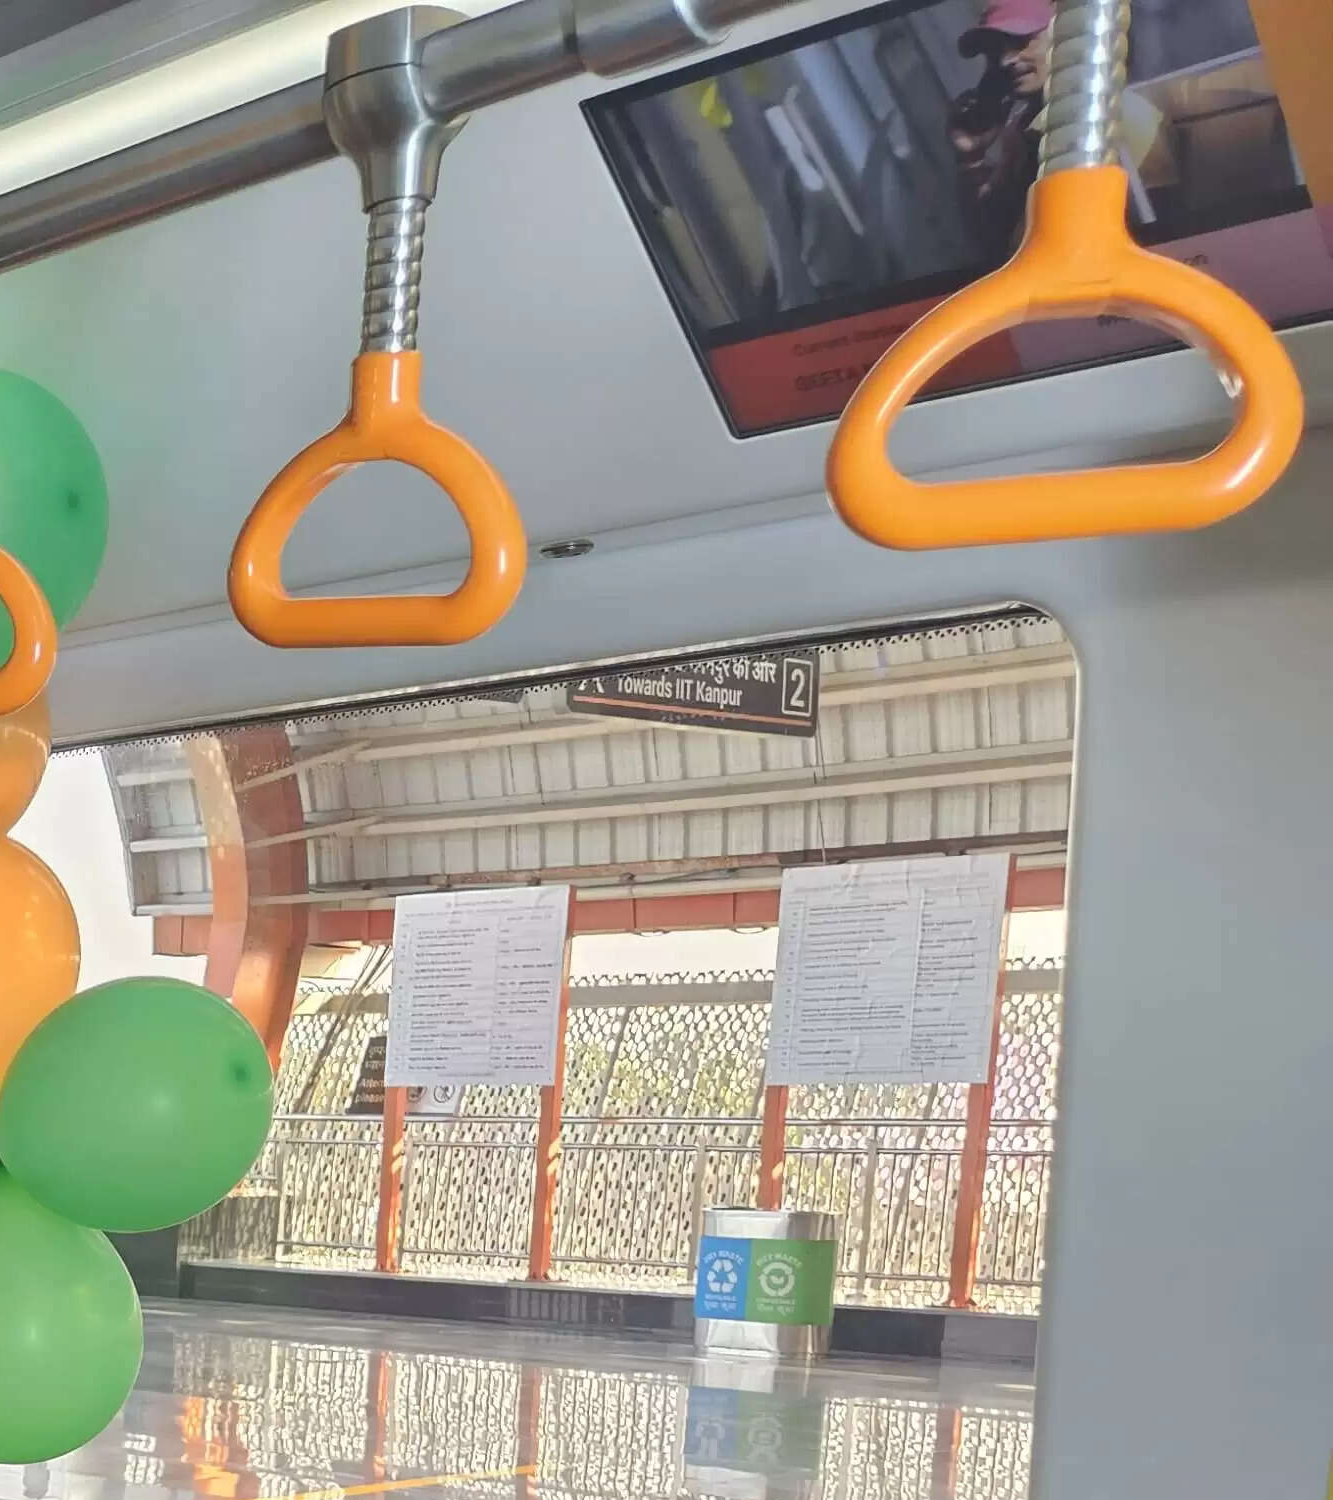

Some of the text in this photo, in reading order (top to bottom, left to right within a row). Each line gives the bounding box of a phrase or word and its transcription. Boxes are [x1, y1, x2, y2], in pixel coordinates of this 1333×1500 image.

[617, 675, 743, 709] Towards IIT Kanpur
[789, 668, 806, 708] 2
